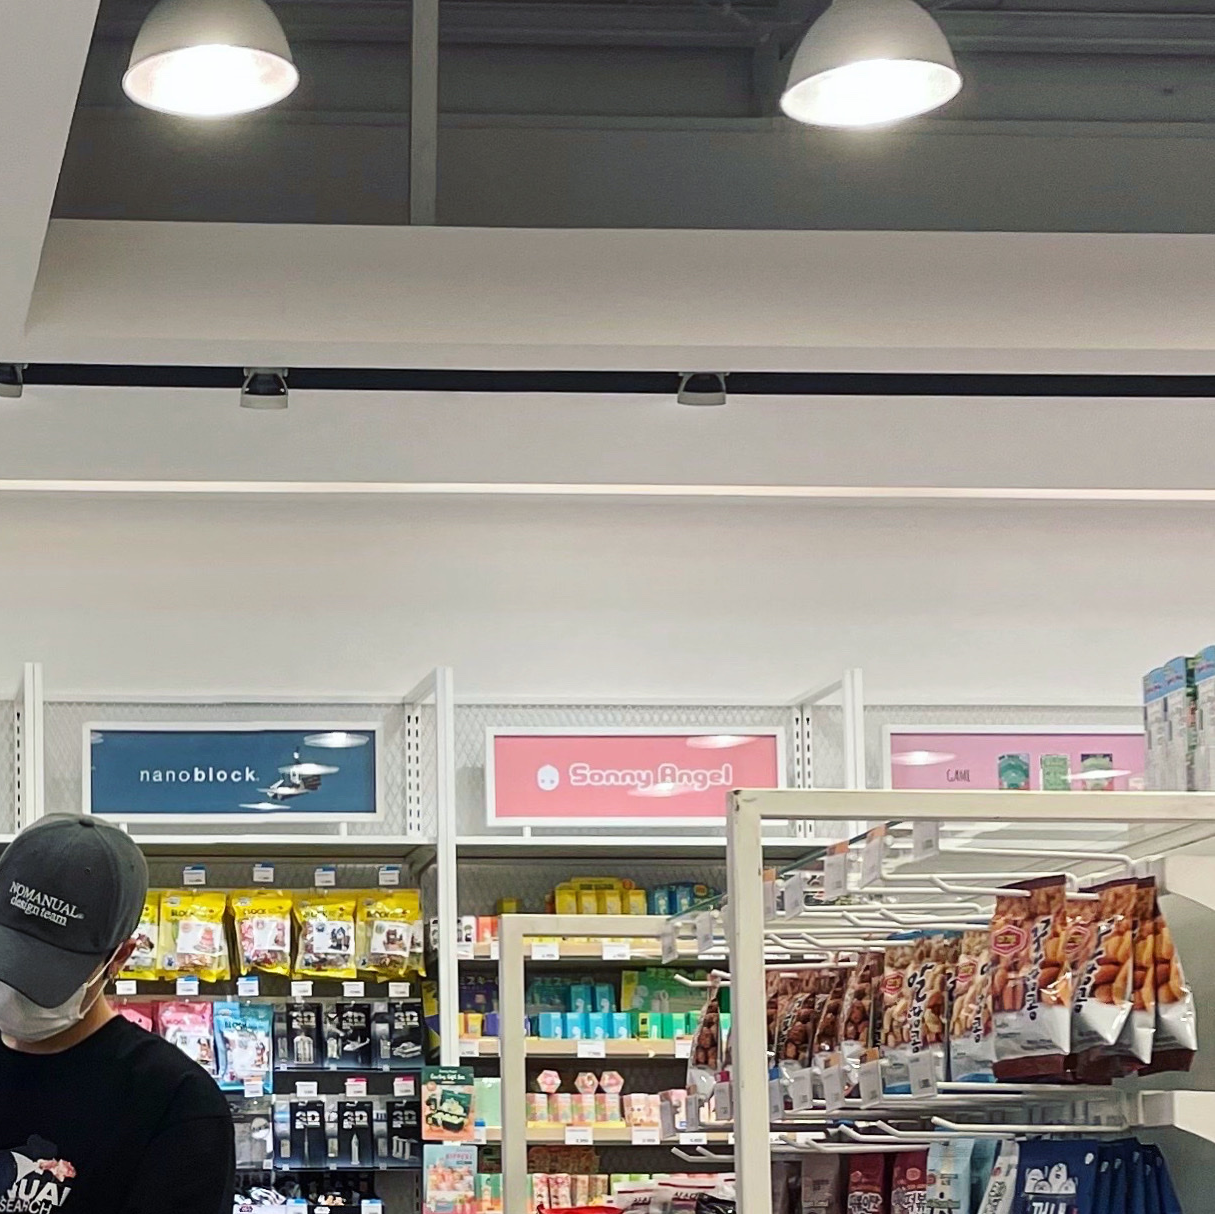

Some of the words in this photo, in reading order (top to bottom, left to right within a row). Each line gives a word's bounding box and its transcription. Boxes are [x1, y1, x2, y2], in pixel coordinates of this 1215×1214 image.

[139, 766, 256, 783] nanoblock
[569, 763, 653, 788] Sonny
[656, 763, 733, 791] Angel
[9, 881, 79, 918] NOMANUAL
[10, 892, 40, 916] design
[40, 907, 68, 927] team
